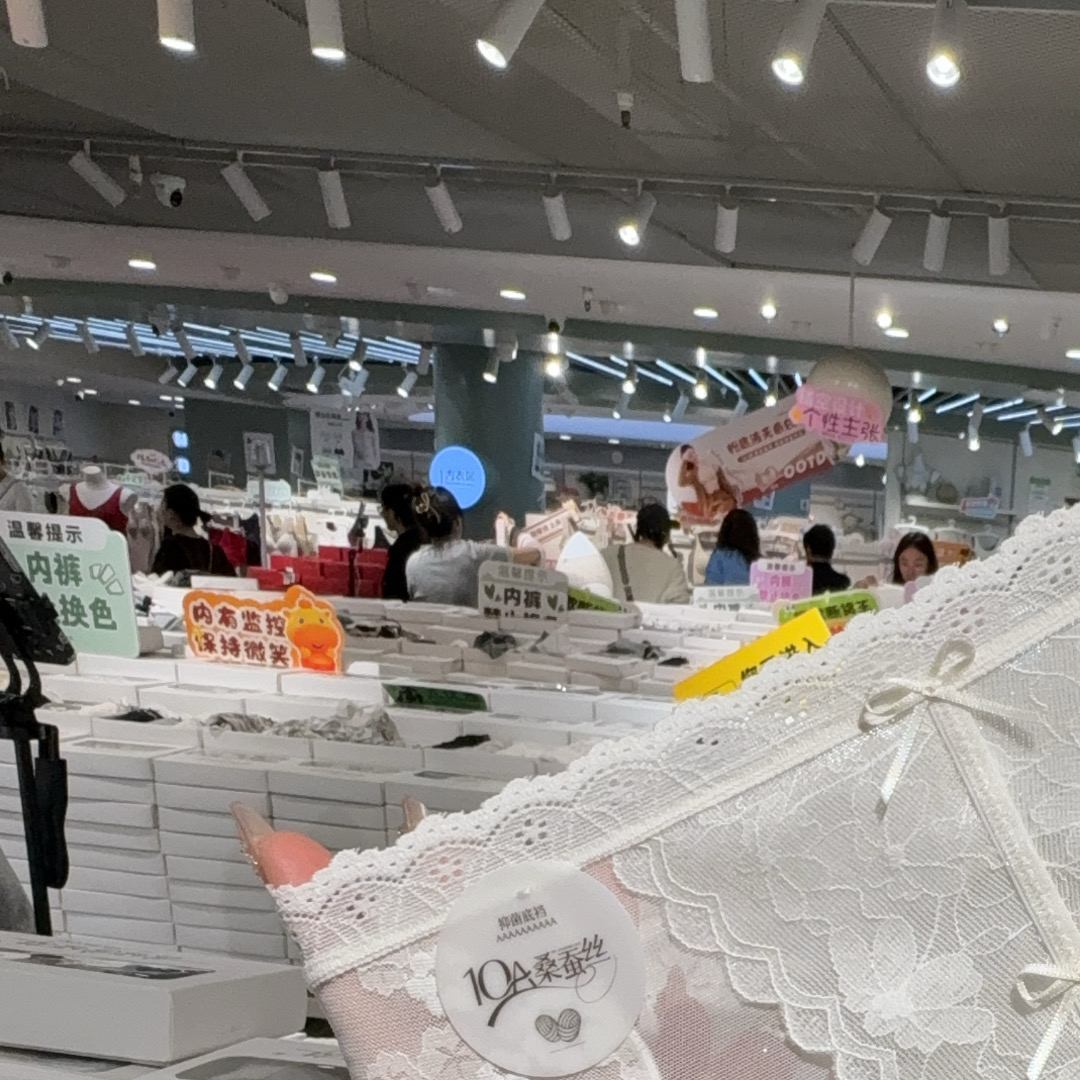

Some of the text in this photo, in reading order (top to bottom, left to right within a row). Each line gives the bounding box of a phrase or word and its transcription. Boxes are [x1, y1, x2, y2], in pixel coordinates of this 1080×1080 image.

[802, 406, 881, 442] 个性主张
[7, 519, 83, 543] 温馨提示
[26, 551, 83, 587] 内裤
[41, 592, 117, 631] 换色
[503, 587, 542, 609] 内裤
[192, 602, 286, 639] 内有监控
[194, 632, 290, 668] 保持微笑
